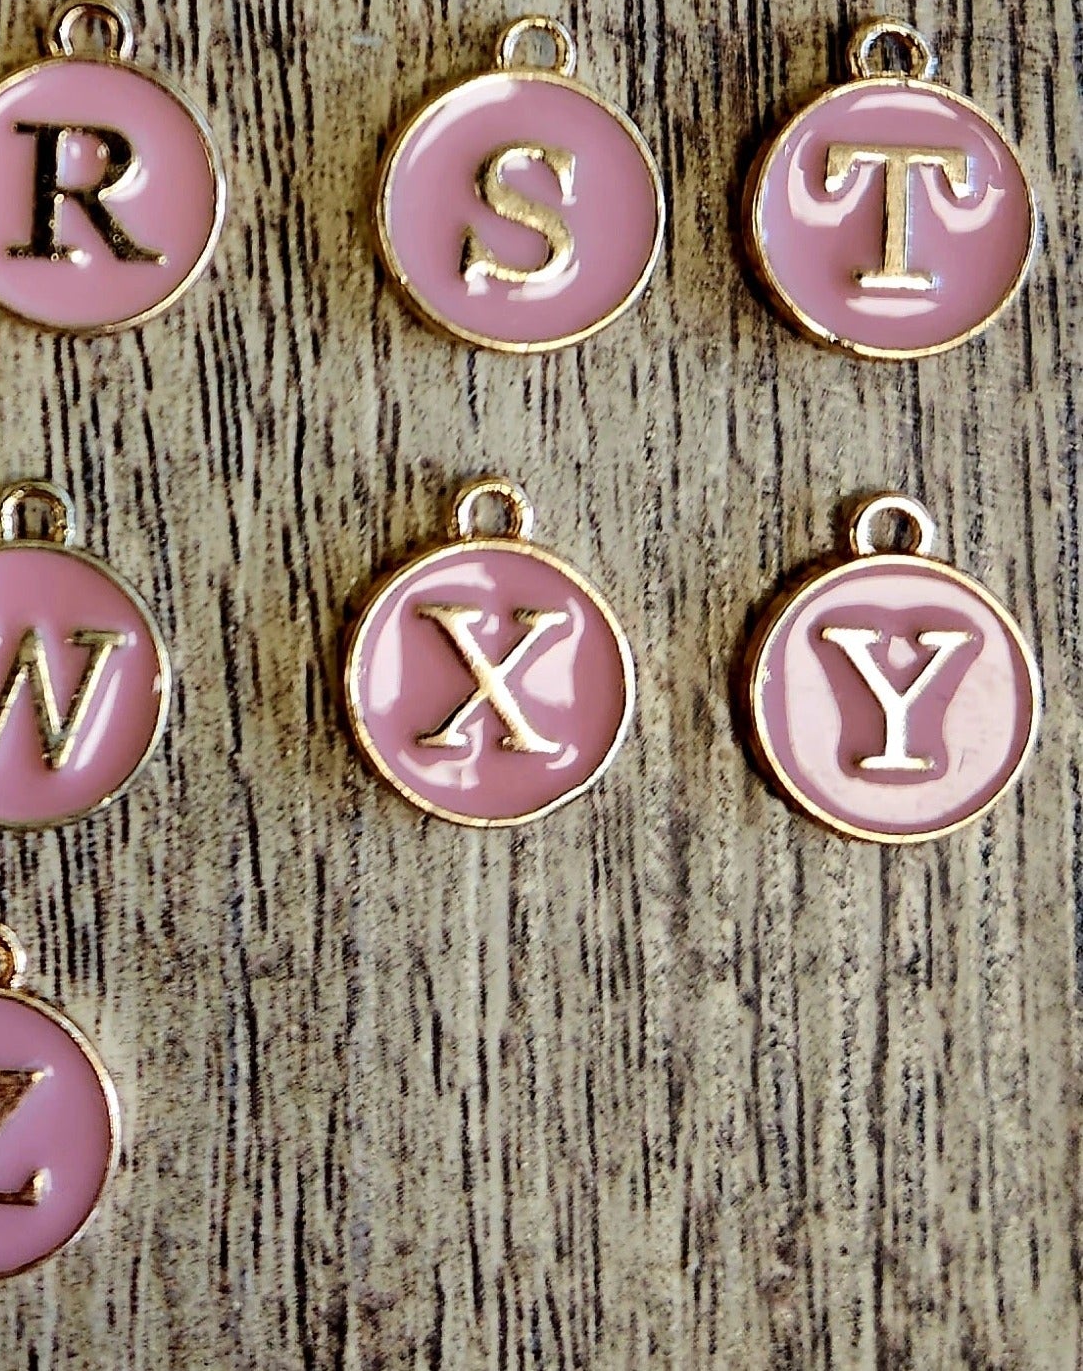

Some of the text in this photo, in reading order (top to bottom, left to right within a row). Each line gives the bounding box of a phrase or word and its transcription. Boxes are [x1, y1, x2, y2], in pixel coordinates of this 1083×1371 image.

[12, 123, 168, 266] R
[459, 147, 576, 283] S
[824, 142, 972, 289] T
[417, 604, 568, 753] X
[821, 627, 975, 769] Y
